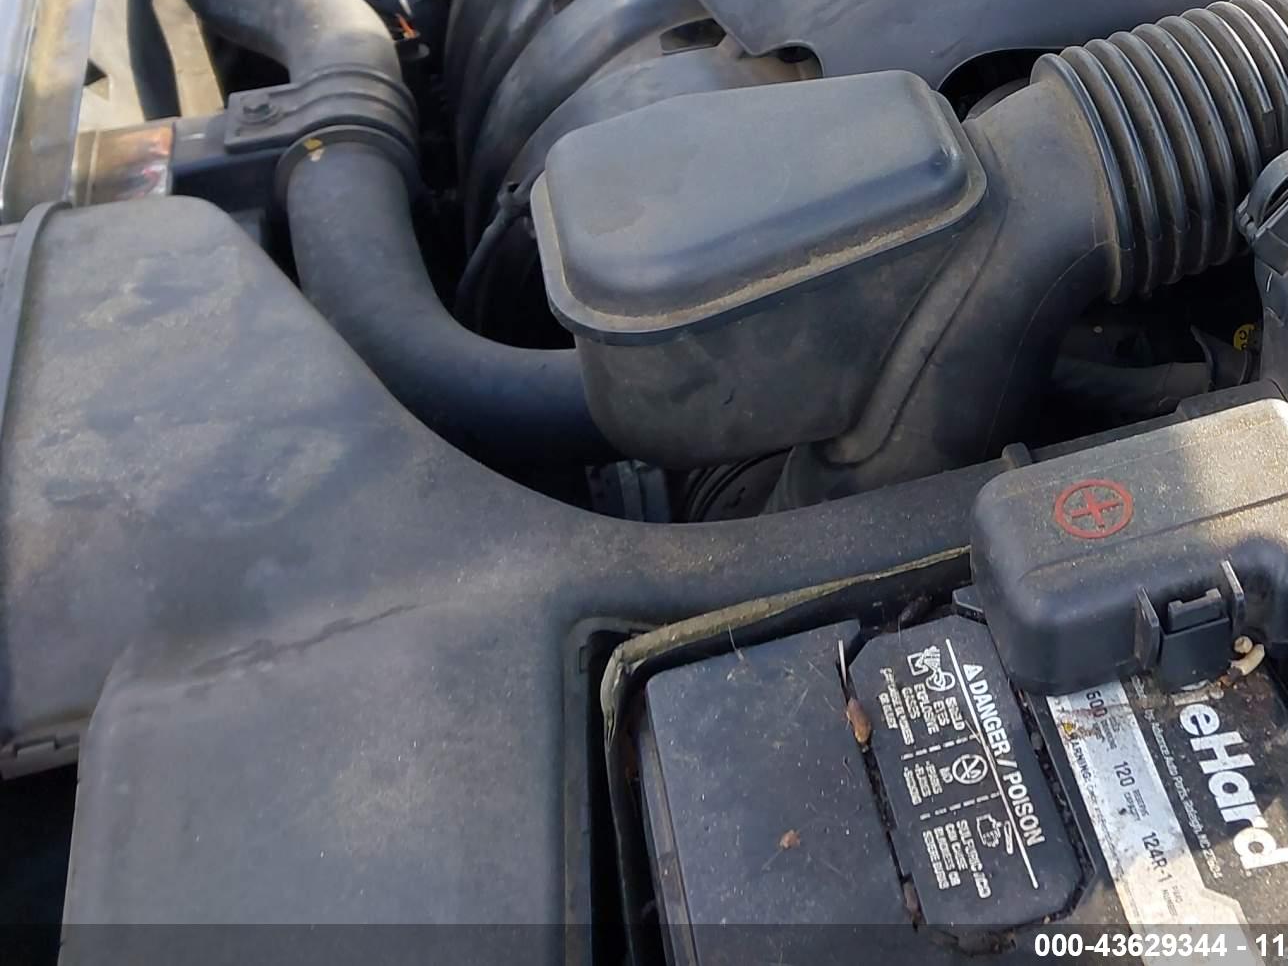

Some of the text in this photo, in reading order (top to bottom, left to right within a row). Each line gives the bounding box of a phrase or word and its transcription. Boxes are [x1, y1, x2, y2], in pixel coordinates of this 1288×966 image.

[968, 678, 1012, 756] DANGER
[1001, 770, 1045, 847] POISON
[1112, 759, 1136, 788] 120
[1141, 830, 1172, 883] 124R-1
